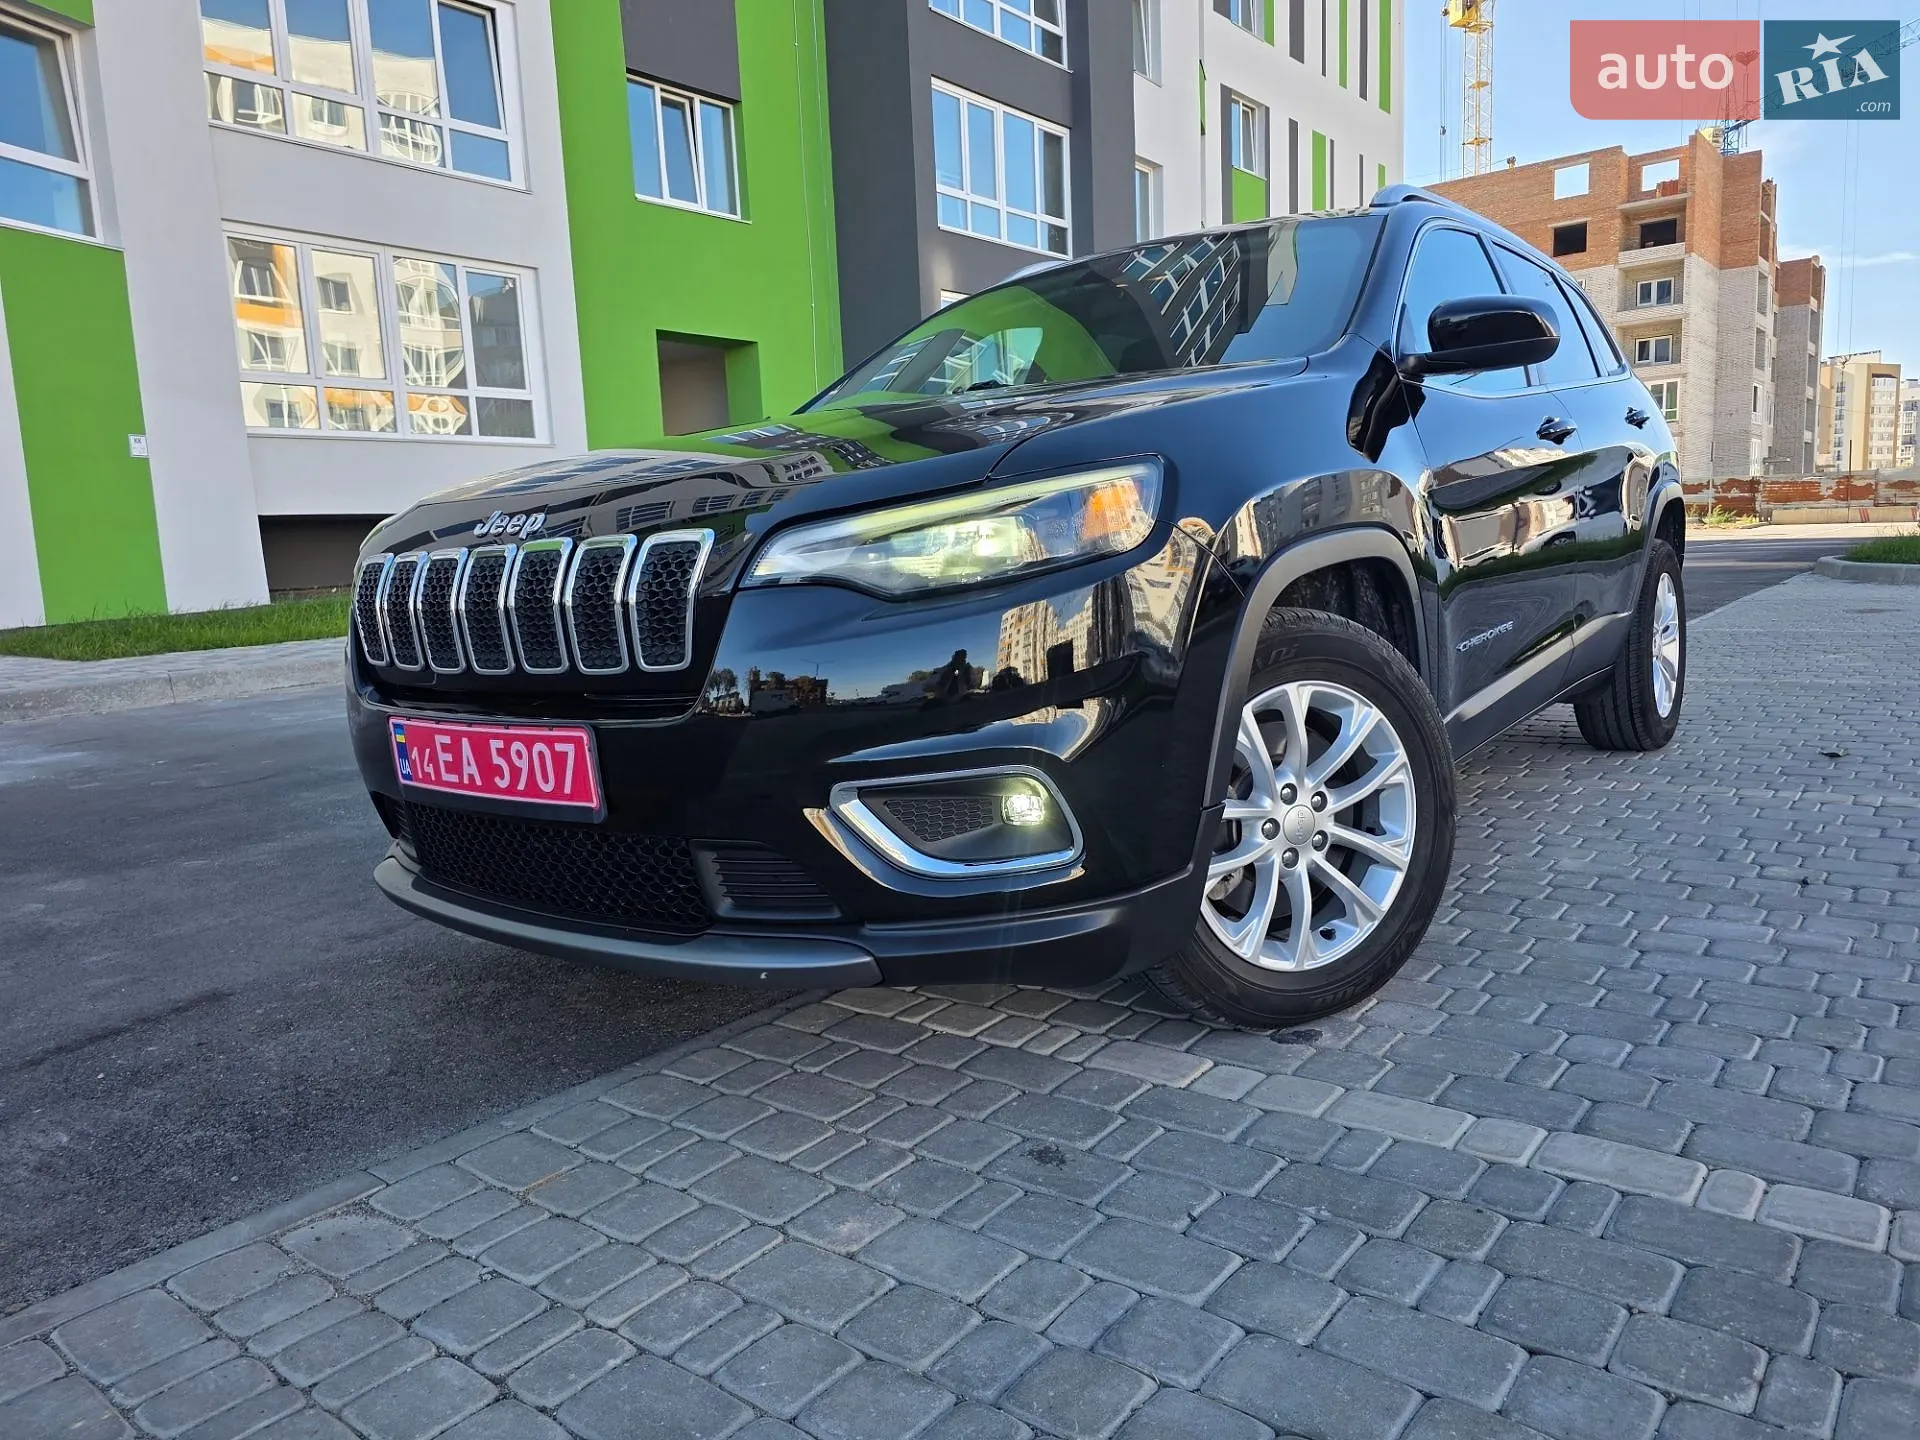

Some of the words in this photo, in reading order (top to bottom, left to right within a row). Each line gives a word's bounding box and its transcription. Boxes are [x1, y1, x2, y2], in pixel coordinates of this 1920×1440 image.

[473, 510, 546, 540] Jeep
[1457, 620, 1514, 651] CHEROKEE
[399, 758, 412, 775] UA
[489, 739, 575, 795] 5907
